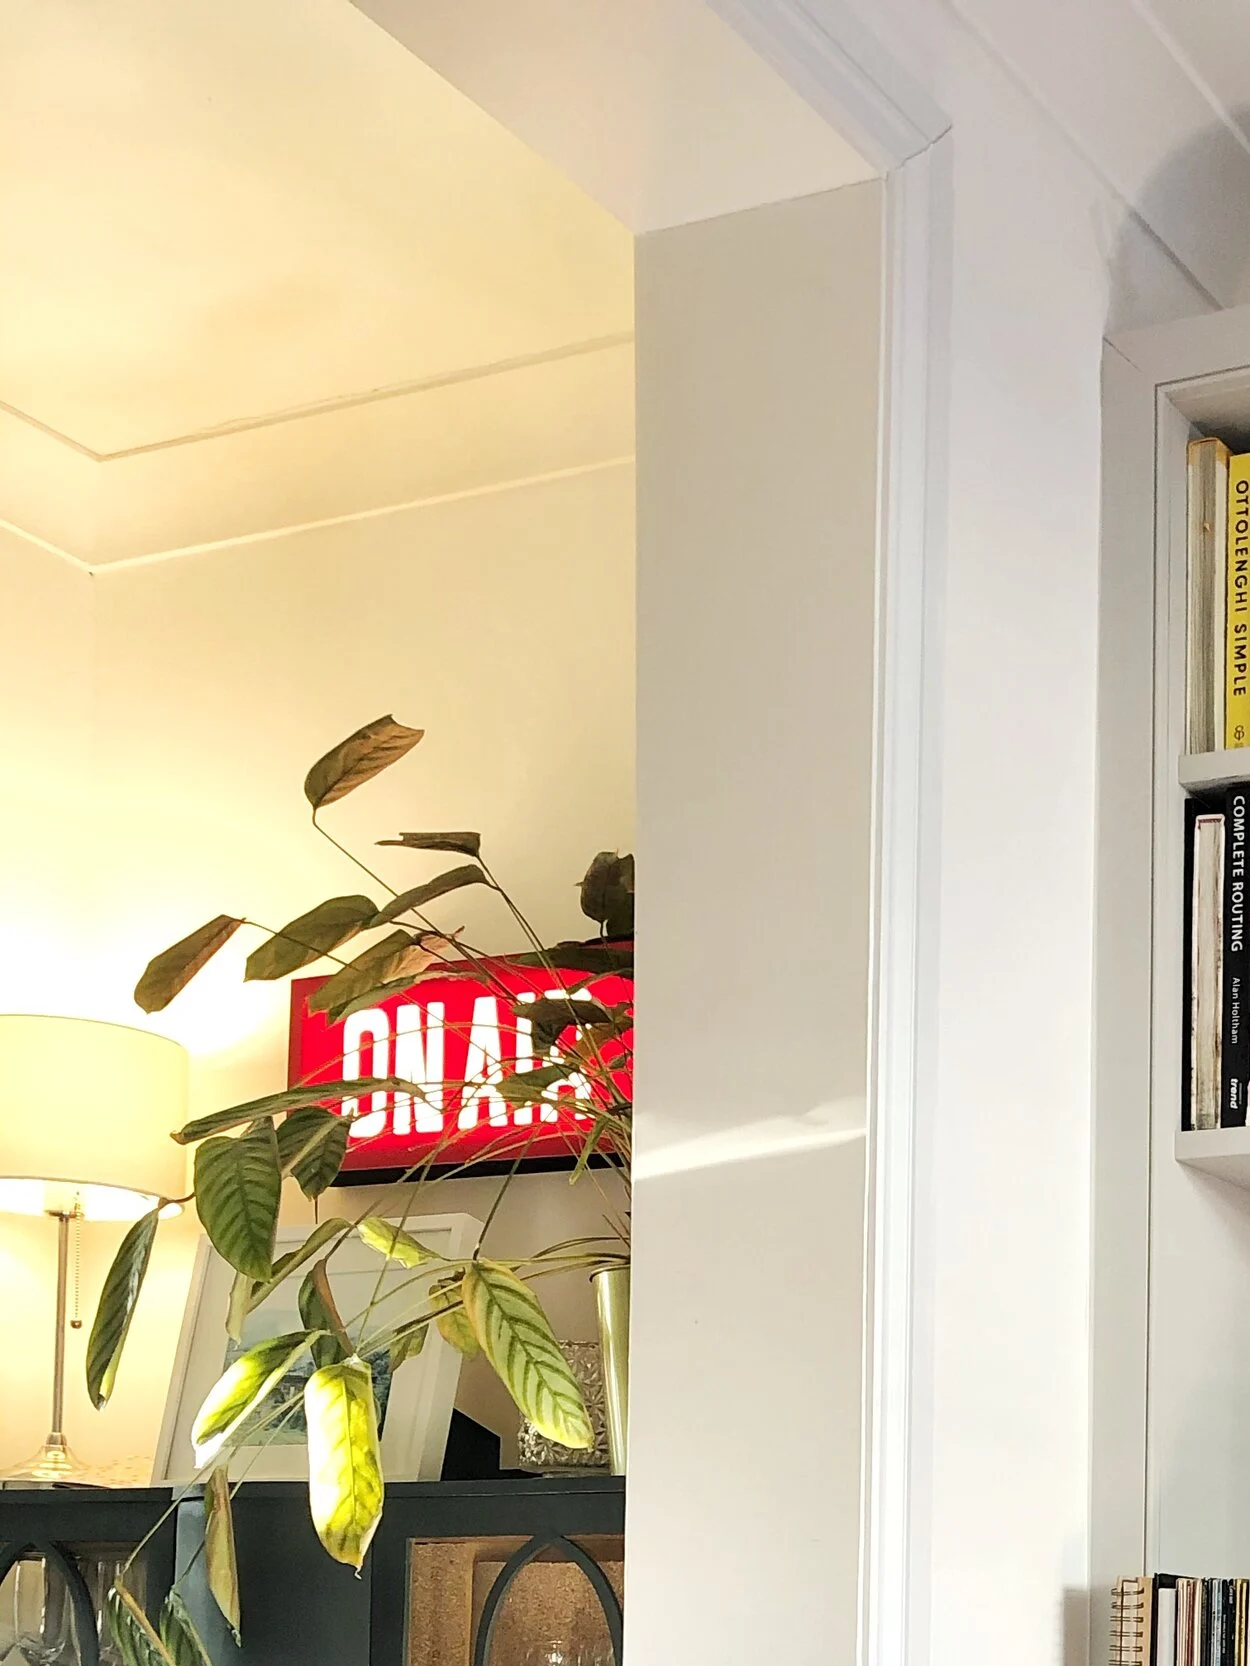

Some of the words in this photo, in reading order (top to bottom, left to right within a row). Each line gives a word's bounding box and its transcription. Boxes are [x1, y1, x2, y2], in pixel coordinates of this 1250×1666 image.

[1233, 480, 1250, 613] OTTOLENGHI
[1232, 623, 1248, 696] SIMPLE
[1233, 796, 1246, 877] COMPLETE
[1230, 881, 1245, 952] ROUTING
[1230, 976, 1241, 1001] Alan
[1230, 1003, 1241, 1044] Holtham
[342, 1001, 445, 1138] ON
[1228, 1078, 1239, 1109] trend
